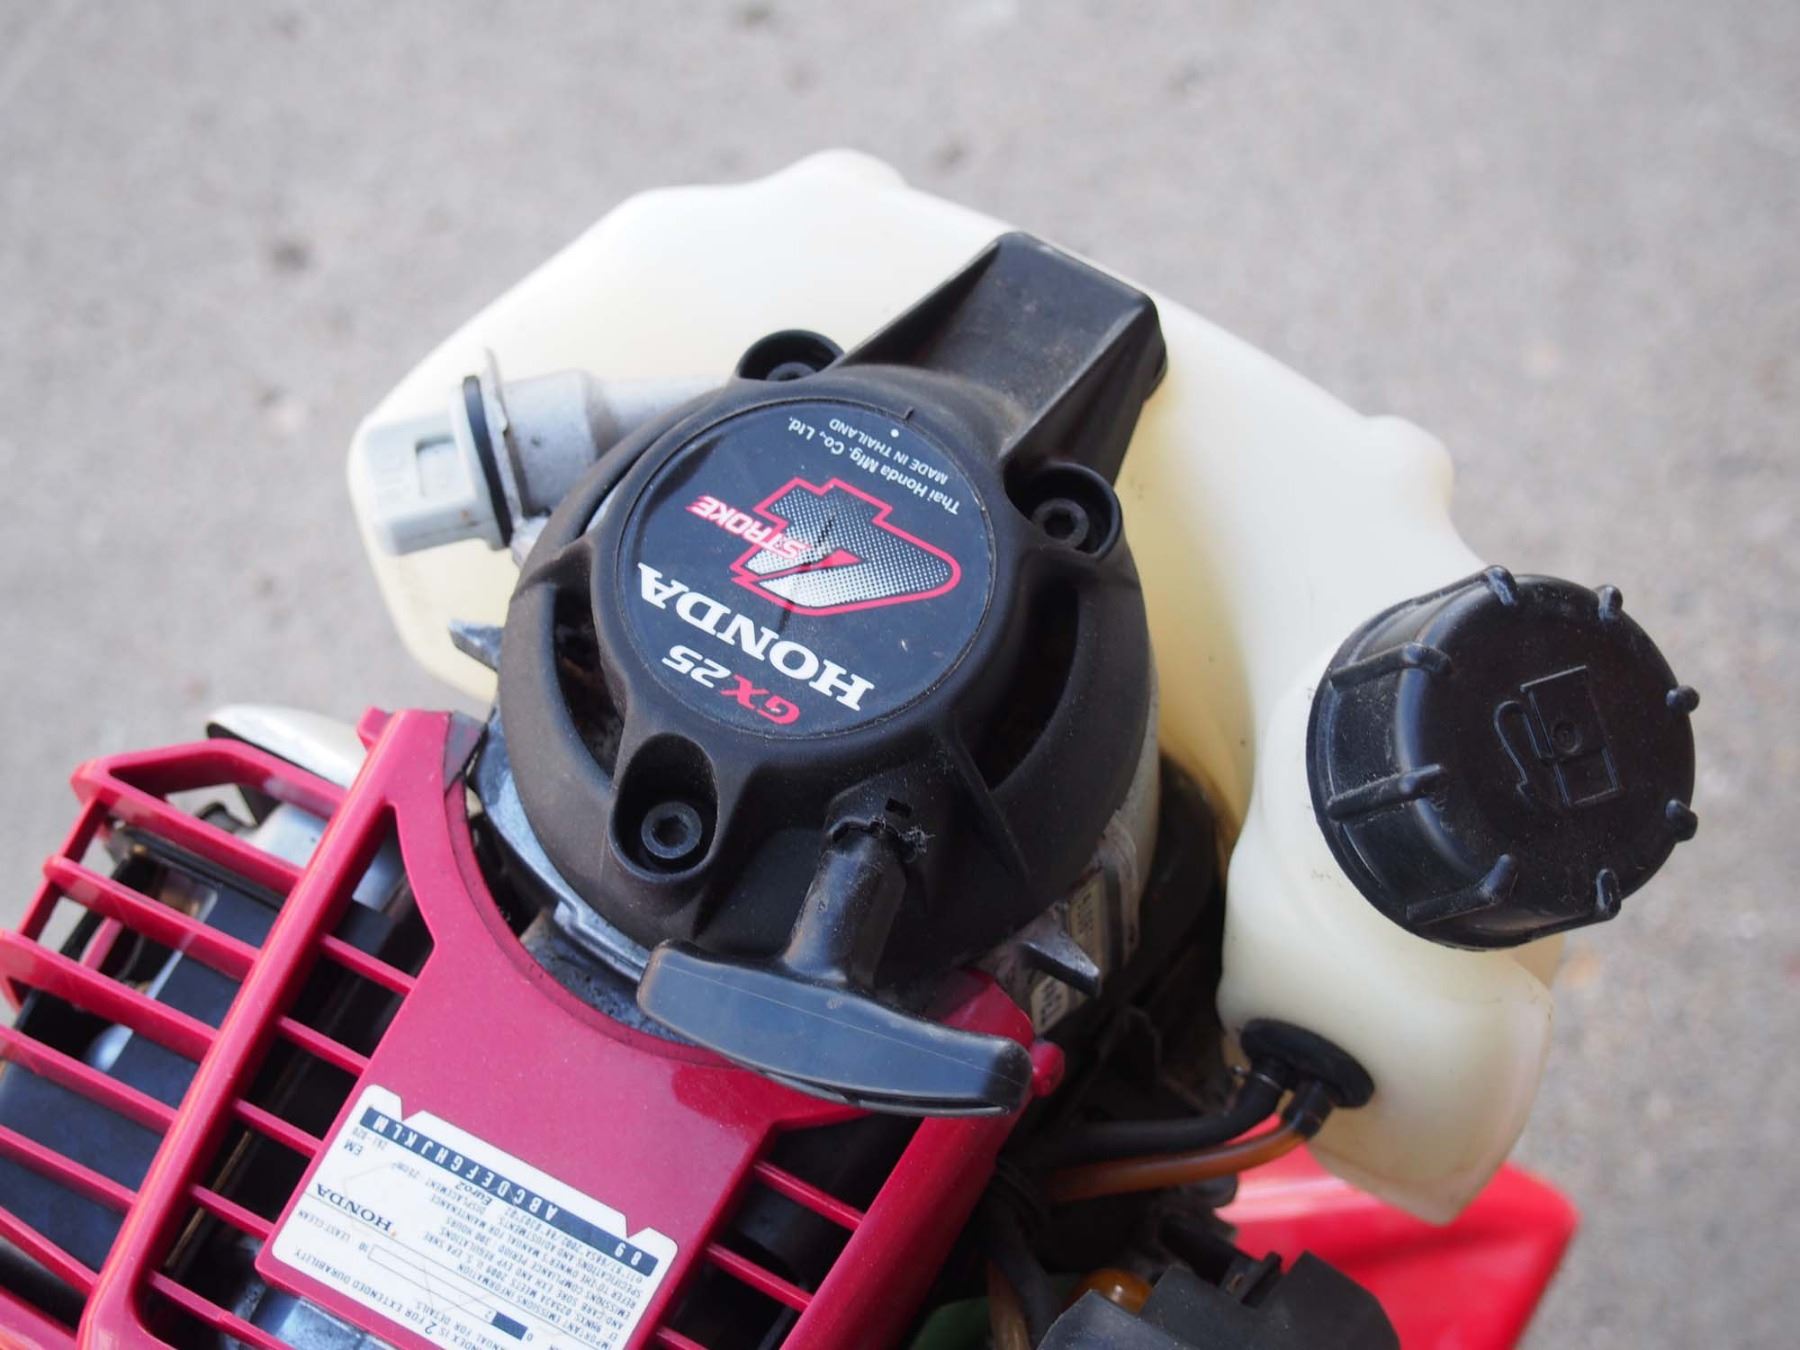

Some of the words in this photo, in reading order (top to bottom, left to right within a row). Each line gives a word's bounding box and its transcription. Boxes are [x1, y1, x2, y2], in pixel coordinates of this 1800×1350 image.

[788, 417, 815, 441] Ltd.
[829, 418, 891, 458] THAILAND
[849, 446, 881, 474] Mfg.
[894, 452, 908, 466] IN
[881, 465, 927, 500] Honda
[909, 459, 948, 485] MADE
[927, 488, 960, 516] Thai
[686, 495, 811, 561] STROKE
[729, 477, 961, 616] 4
[637, 562, 874, 711] HONDA
[343, 1138, 363, 1155] EM
[454, 1180, 492, 1206] Euro2
[314, 1183, 392, 1231] HONDA
[430, 1194, 486, 1229] MAINTENANCE
[488, 1225, 504, 1238] FOR
[506, 1234, 540, 1257] MANUAL
[556, 1247, 574, 1262] AND
[457, 1263, 514, 1298] INFORMATION
[580, 1274, 595, 1287] THE
[596, 1283, 609, 1294] TO
[351, 1279, 402, 1312] EXTENDED
[610, 1290, 635, 1309] REFER
[404, 1309, 424, 1323] FOR
[424, 1320, 436, 1335] 2
[453, 1321, 471, 1335] FOR
[605, 1316, 623, 1330] AND
[438, 1327, 449, 1337] IS
